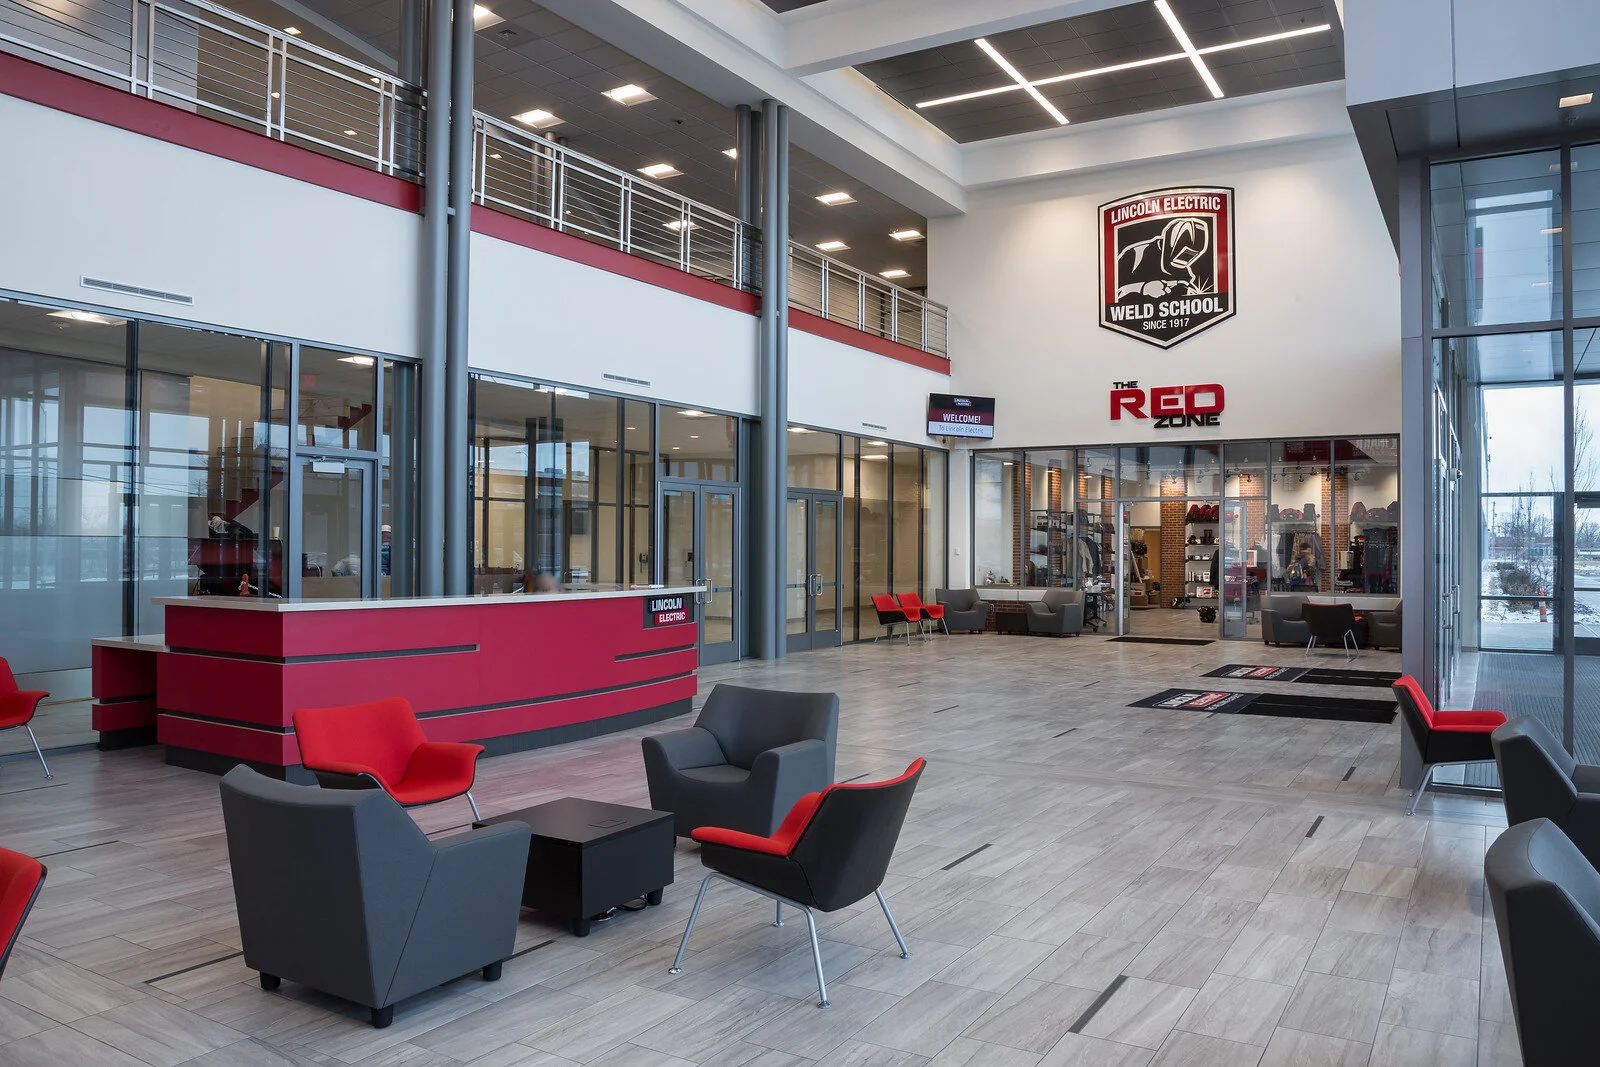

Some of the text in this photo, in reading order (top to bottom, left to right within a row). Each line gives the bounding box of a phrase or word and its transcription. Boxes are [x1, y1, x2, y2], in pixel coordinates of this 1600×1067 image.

[1111, 195, 1221, 224] LINCOLN ELECTRIC
[1110, 297, 1223, 322] WELD SCHOOL
[1143, 317, 1190, 330] SINCE 1917
[1113, 381, 1138, 389] THE
[1110, 383, 1225, 420] RED
[942, 413, 981, 424] WELCOME!
[1153, 412, 1221, 428] ZONE
[946, 425, 964, 433] Lincoln
[651, 598, 683, 612] LINCOLN
[659, 612, 686, 623] ELECTRIC
